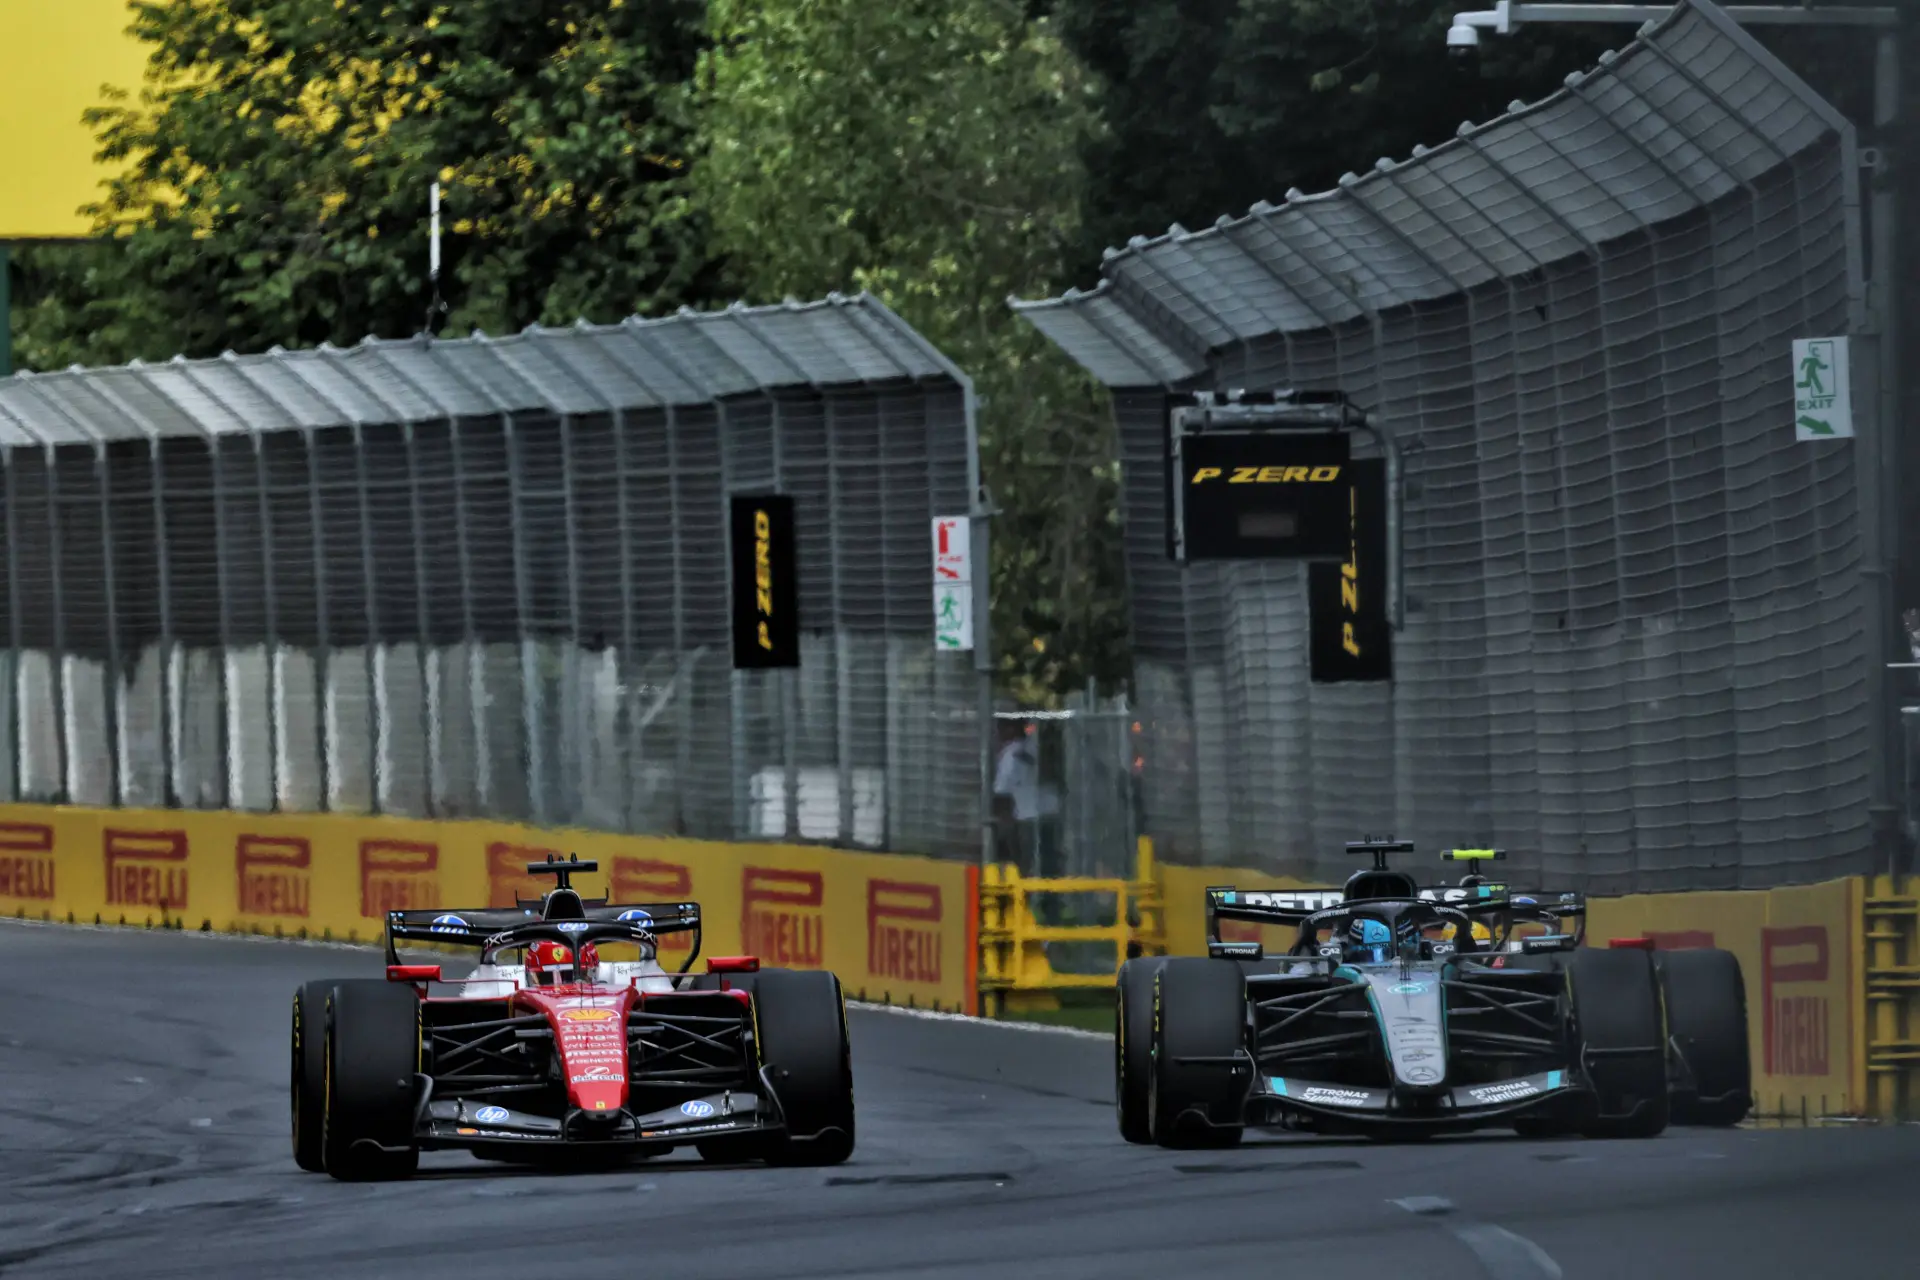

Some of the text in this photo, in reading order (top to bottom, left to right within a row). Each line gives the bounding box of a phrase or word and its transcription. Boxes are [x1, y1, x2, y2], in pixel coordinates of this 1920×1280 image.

[1797, 399, 1833, 410] EXIT
[1191, 466, 1342, 484] P ZERO
[755, 509, 773, 651] P ZERO
[1343, 622, 1360, 658] P
[103, 827, 189, 910] PIRELLI
[236, 833, 311, 917] PIRELLI
[741, 864, 825, 968] PIRELLI
[867, 877, 943, 984] PIRELLI
[1224, 947, 1257, 956] PETRONAS
[1761, 925, 1830, 1078] PIRELLI
[1305, 1087, 1370, 1099] PETRONAS
[1469, 1080, 1531, 1097] PETRONAS
[481, 1106, 505, 1123] hp
[686, 1100, 709, 1117] hp
